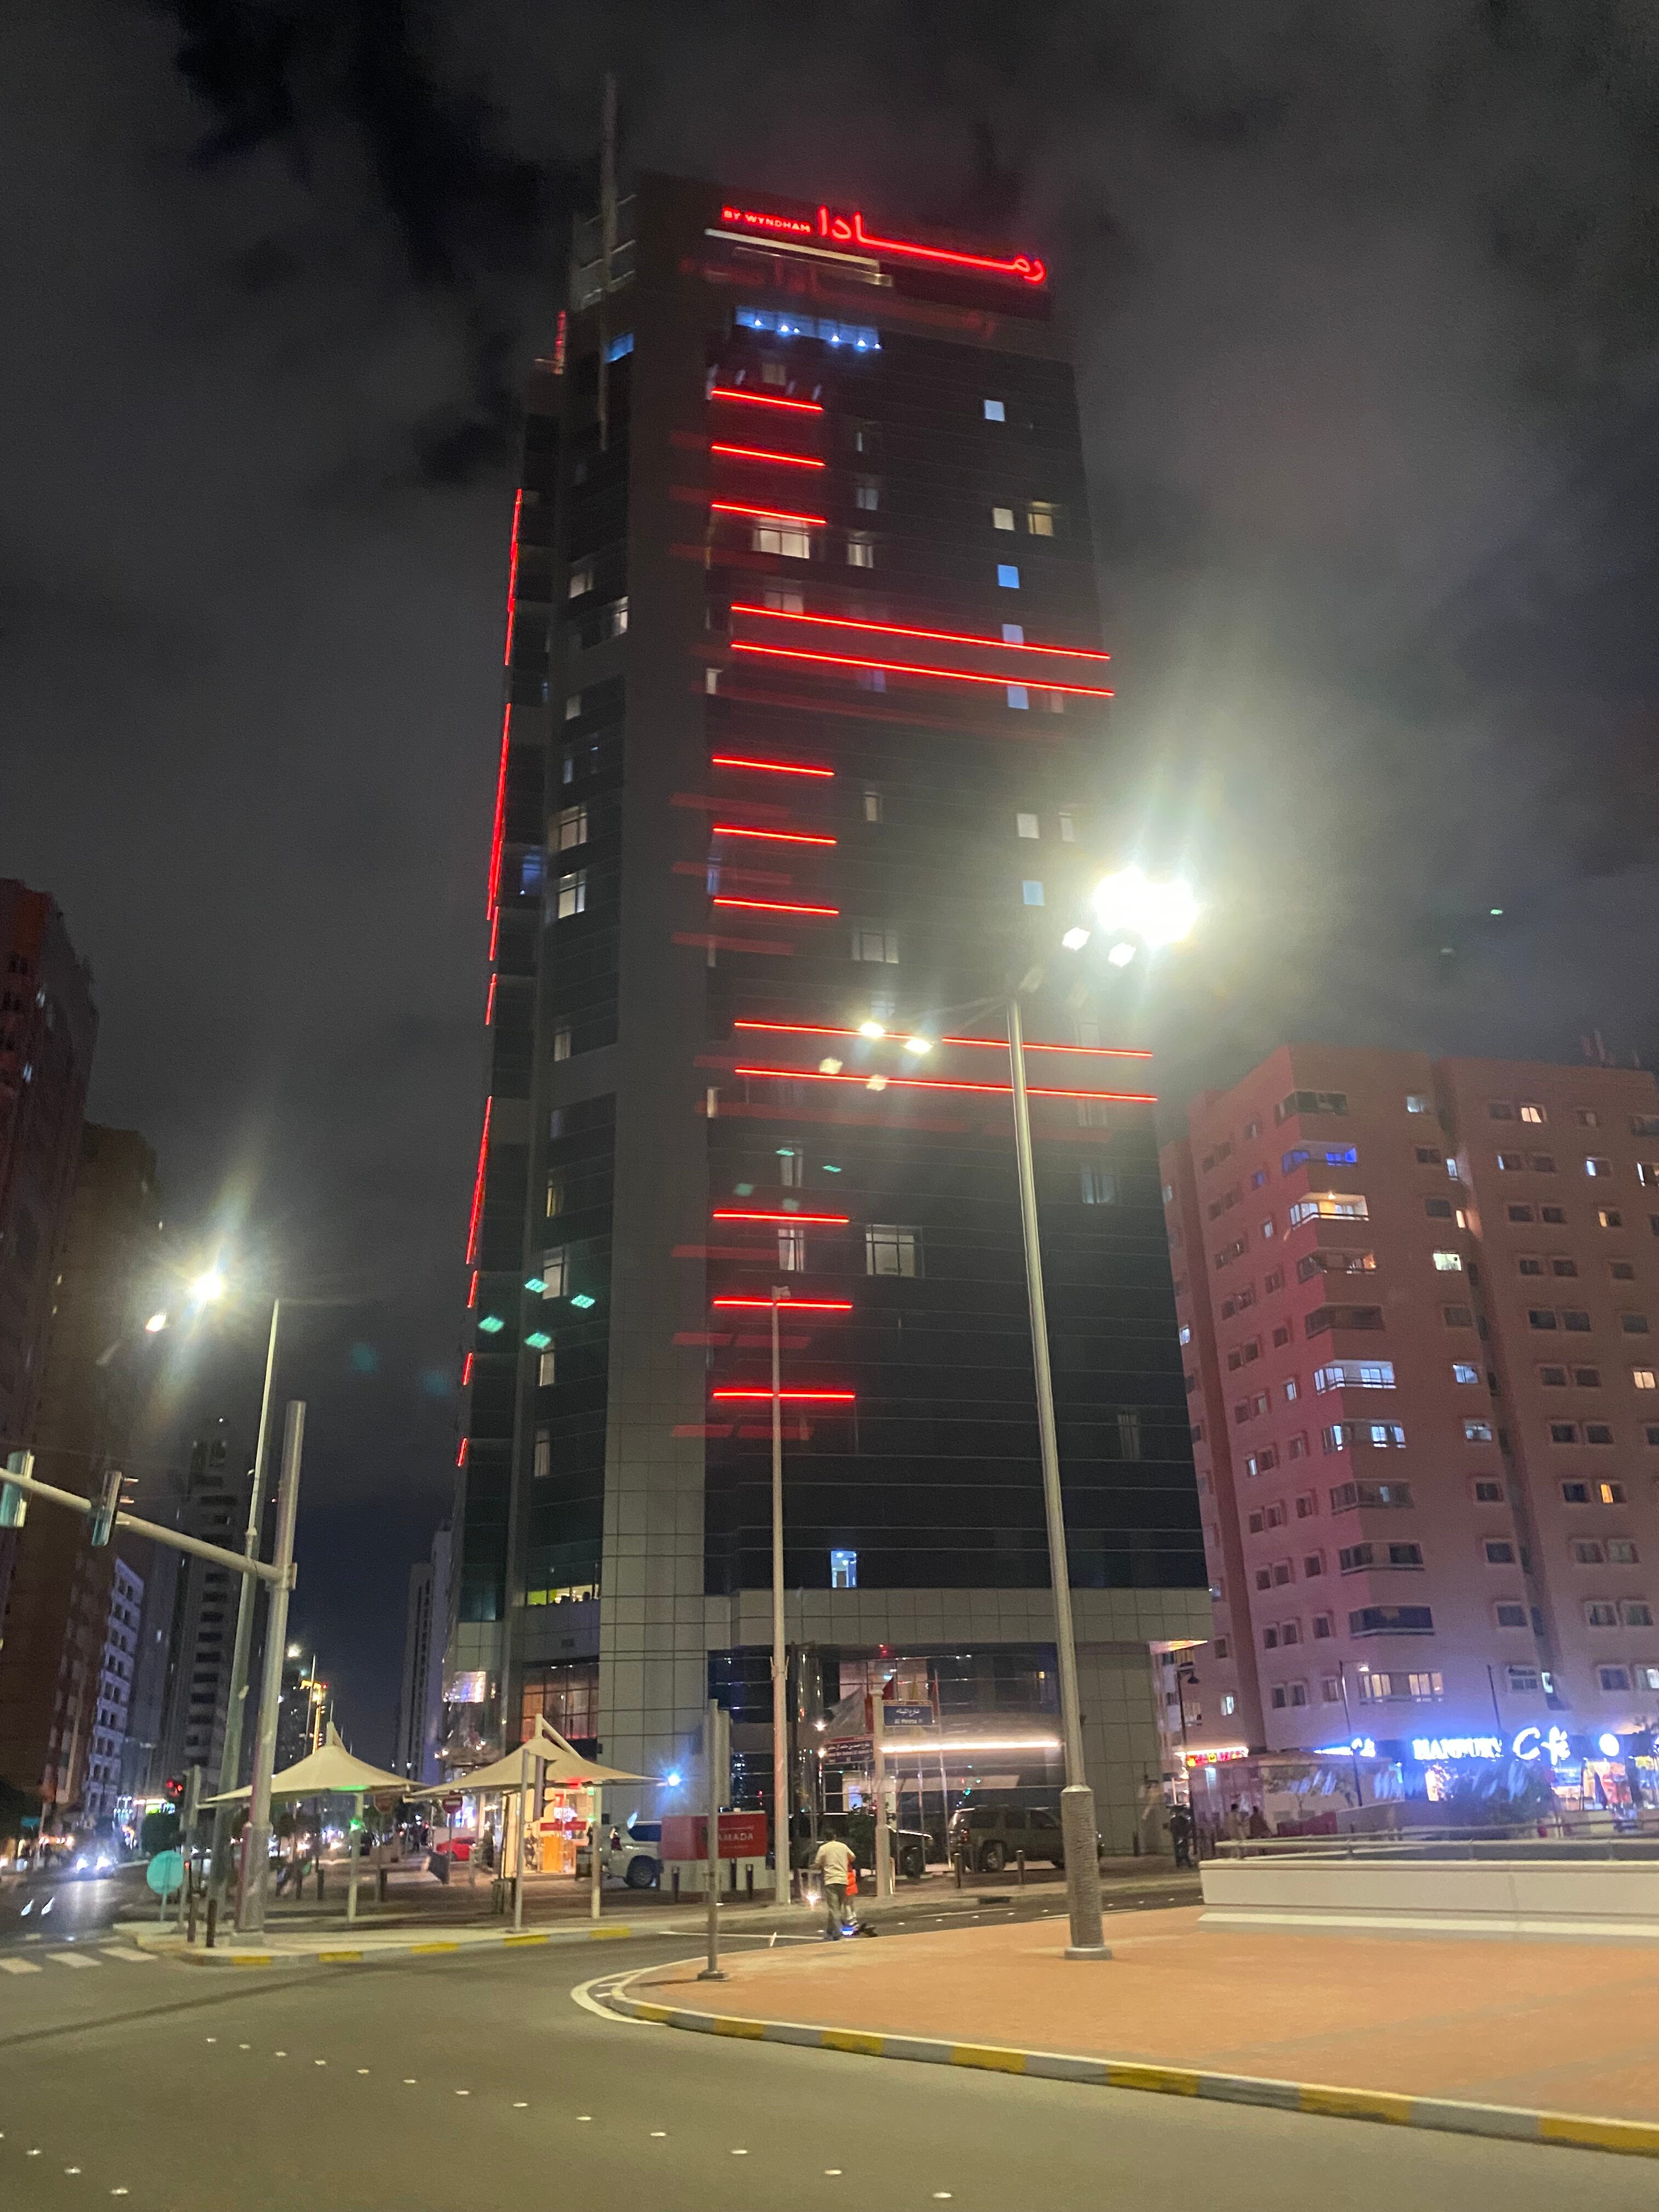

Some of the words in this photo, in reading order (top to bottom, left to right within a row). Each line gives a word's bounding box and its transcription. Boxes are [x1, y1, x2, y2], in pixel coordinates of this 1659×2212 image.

[723, 208, 741, 221] BY
[743, 212, 812, 233] WYNDHAM
[817, 205, 1046, 282] رمادا
[718, 1832, 753, 1842] AMADA
